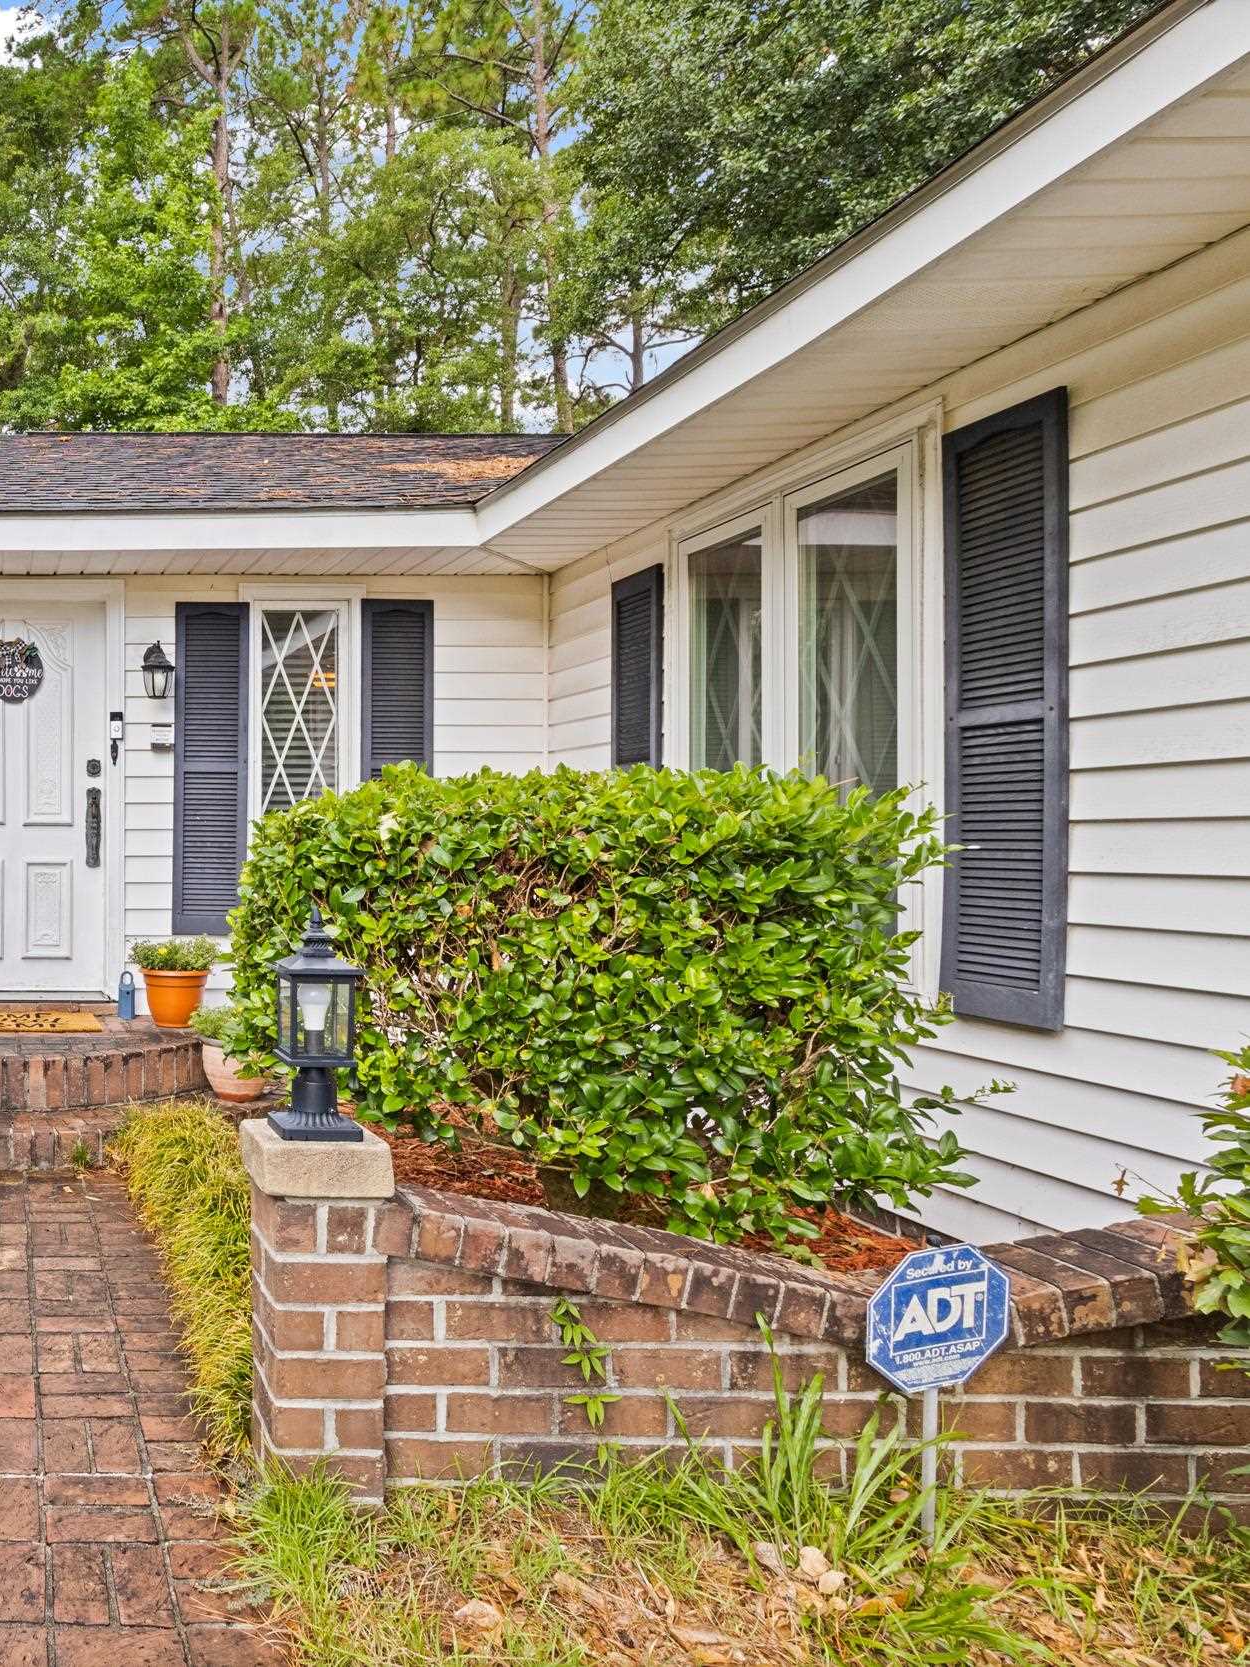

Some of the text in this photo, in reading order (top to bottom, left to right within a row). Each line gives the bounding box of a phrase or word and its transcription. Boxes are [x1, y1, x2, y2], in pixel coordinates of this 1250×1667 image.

[906, 1258, 973, 1280] Secured by
[893, 1280, 987, 1342] ADT
[894, 1340, 981, 1365] 1.800.ADT.ASAP
[912, 1353, 961, 1367] www.adt.com
